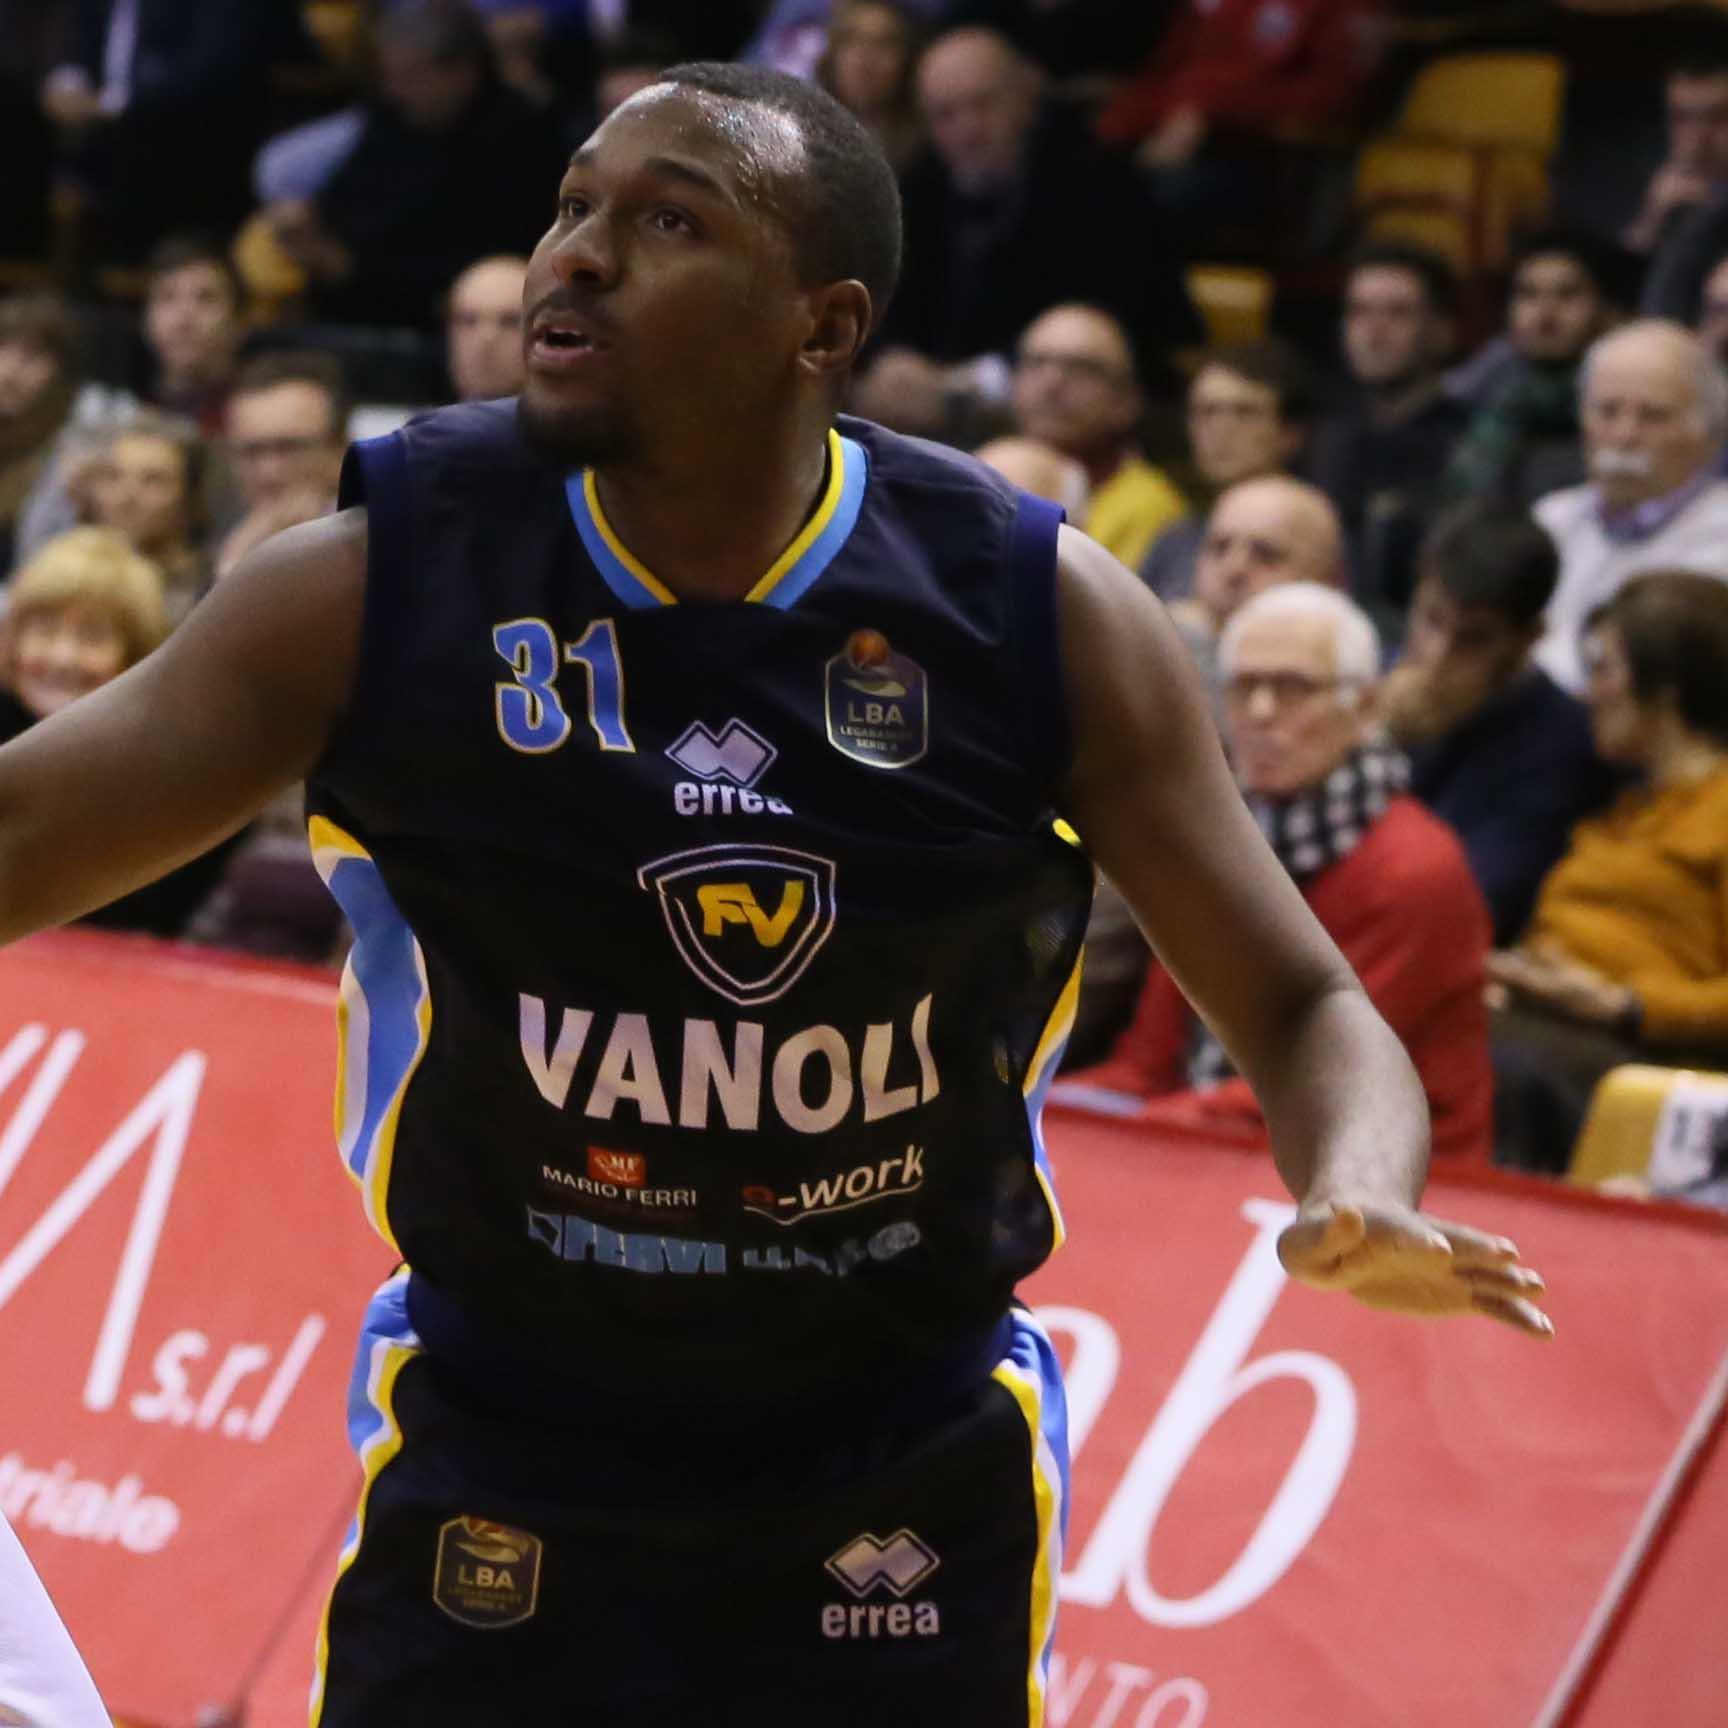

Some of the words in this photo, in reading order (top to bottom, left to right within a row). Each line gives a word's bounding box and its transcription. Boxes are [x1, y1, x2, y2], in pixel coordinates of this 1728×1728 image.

[491, 617, 635, 754] 31
[847, 701, 905, 727] LBA
[518, 991, 941, 1135] VANOLI
[542, 1165, 619, 1200] MARIO
[625, 1187, 697, 1208] FERRI
[457, 1563, 515, 1591] LBA
[820, 1601, 940, 1639] errea
